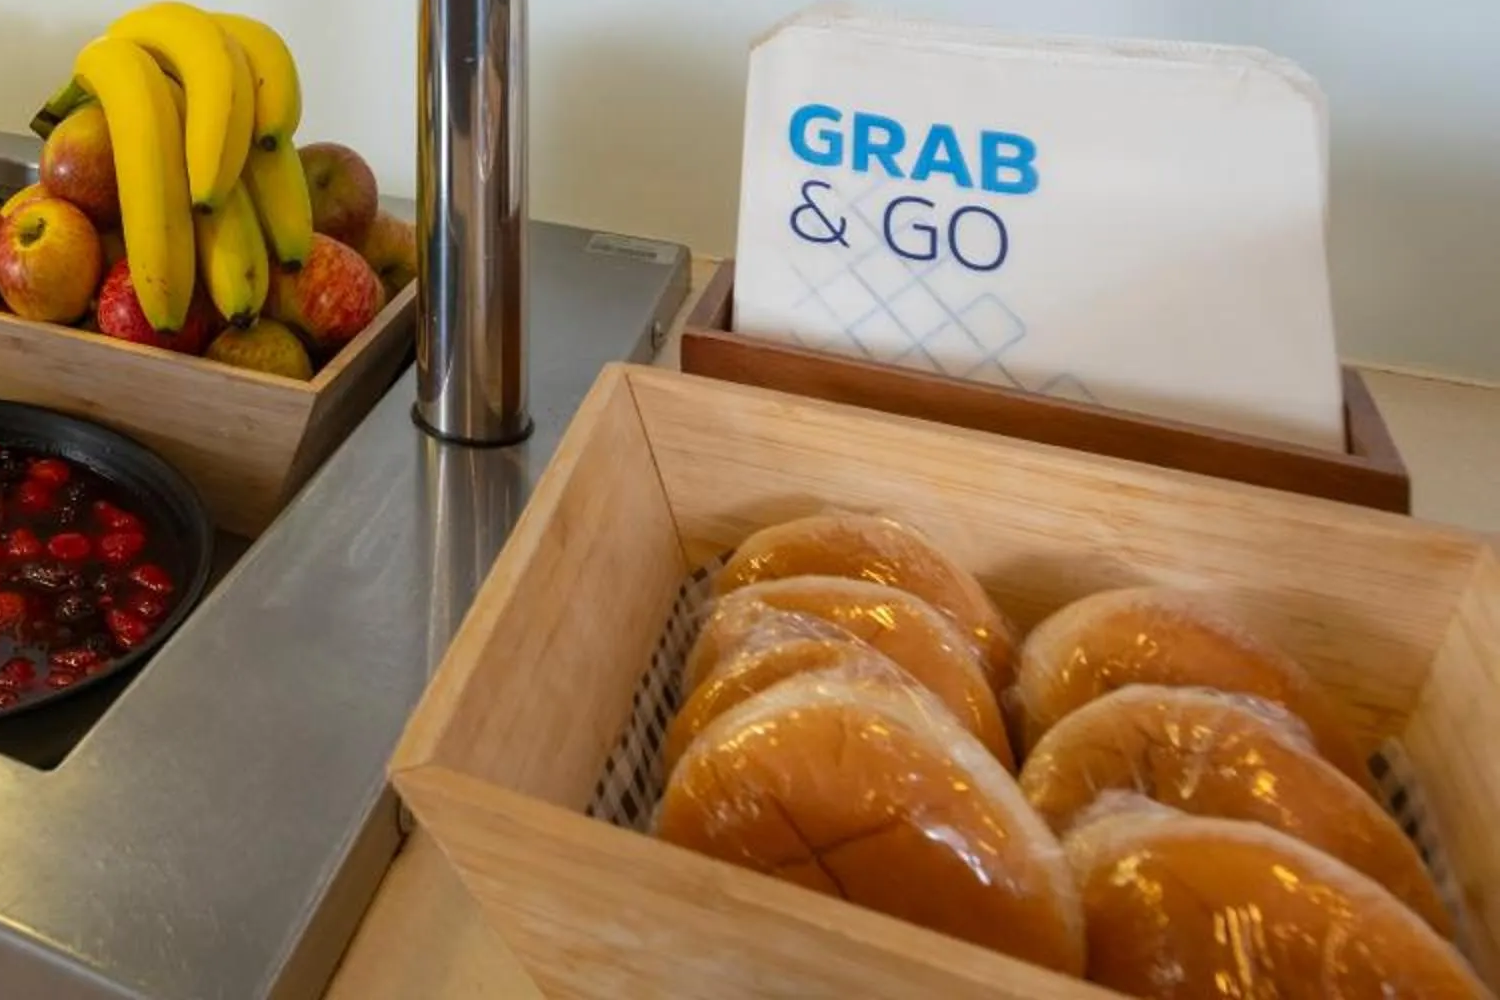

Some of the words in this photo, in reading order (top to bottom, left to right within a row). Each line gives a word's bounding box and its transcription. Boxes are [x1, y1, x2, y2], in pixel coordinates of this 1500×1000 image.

[788, 103, 1040, 196] GRAB
[789, 179, 850, 249] &
[883, 195, 1008, 272] GO
